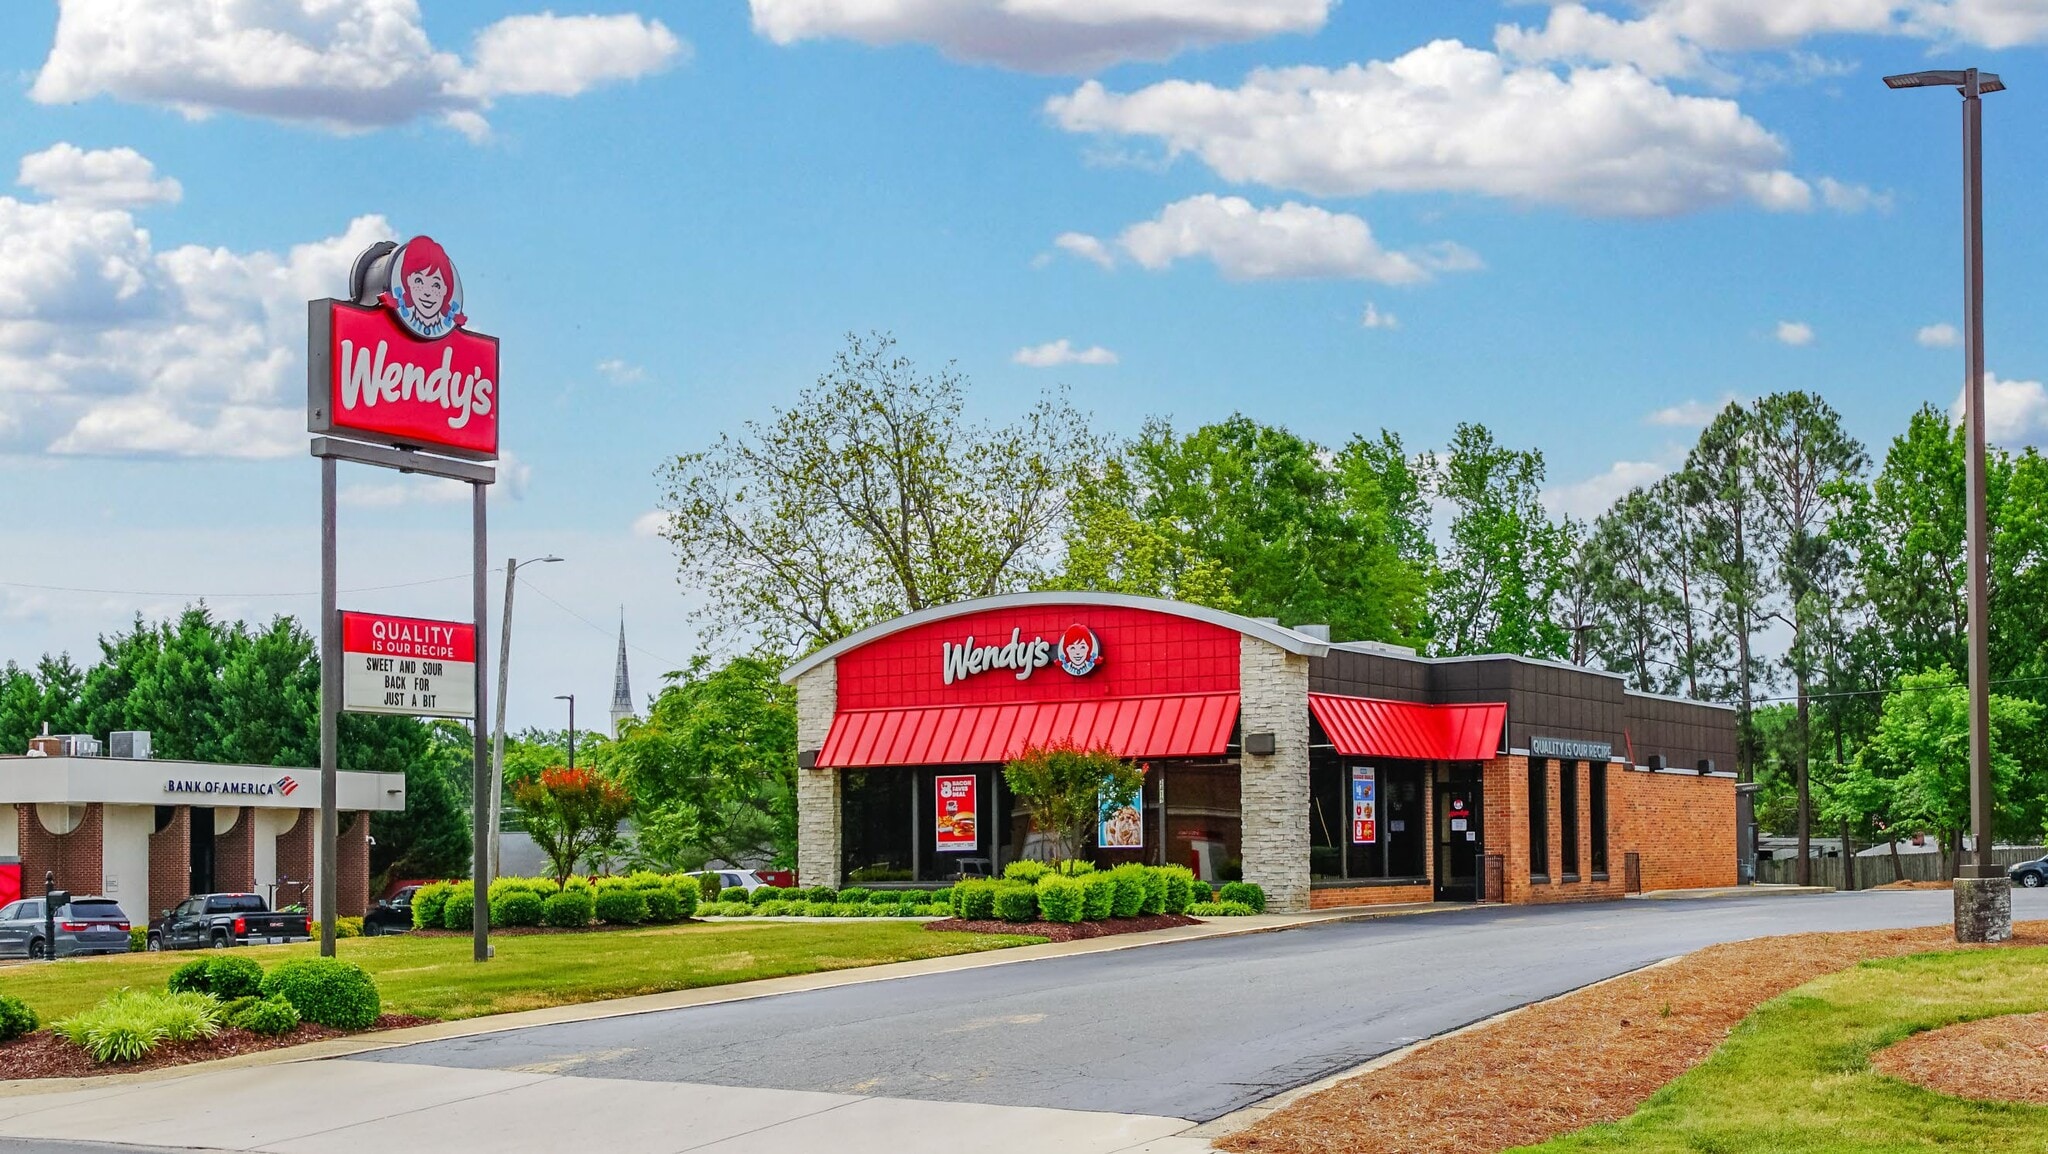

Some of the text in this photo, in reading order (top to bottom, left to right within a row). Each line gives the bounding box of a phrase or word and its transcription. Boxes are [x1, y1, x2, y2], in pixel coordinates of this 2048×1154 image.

[340, 339, 493, 430] Wendy's
[372, 621, 454, 645] QUALITY
[372, 640, 454, 657] IS OUR RECIPE
[943, 627, 1050, 685] Wendy's
[366, 657, 443, 676] SWEET AND SOUR
[385, 675, 430, 691] BACK FOR
[384, 692, 436, 708] JUST A BIT
[1533, 740, 1612, 758] QUALITY IS OUR RECIPE
[168, 780, 274, 795] BANK OF AMERICA
